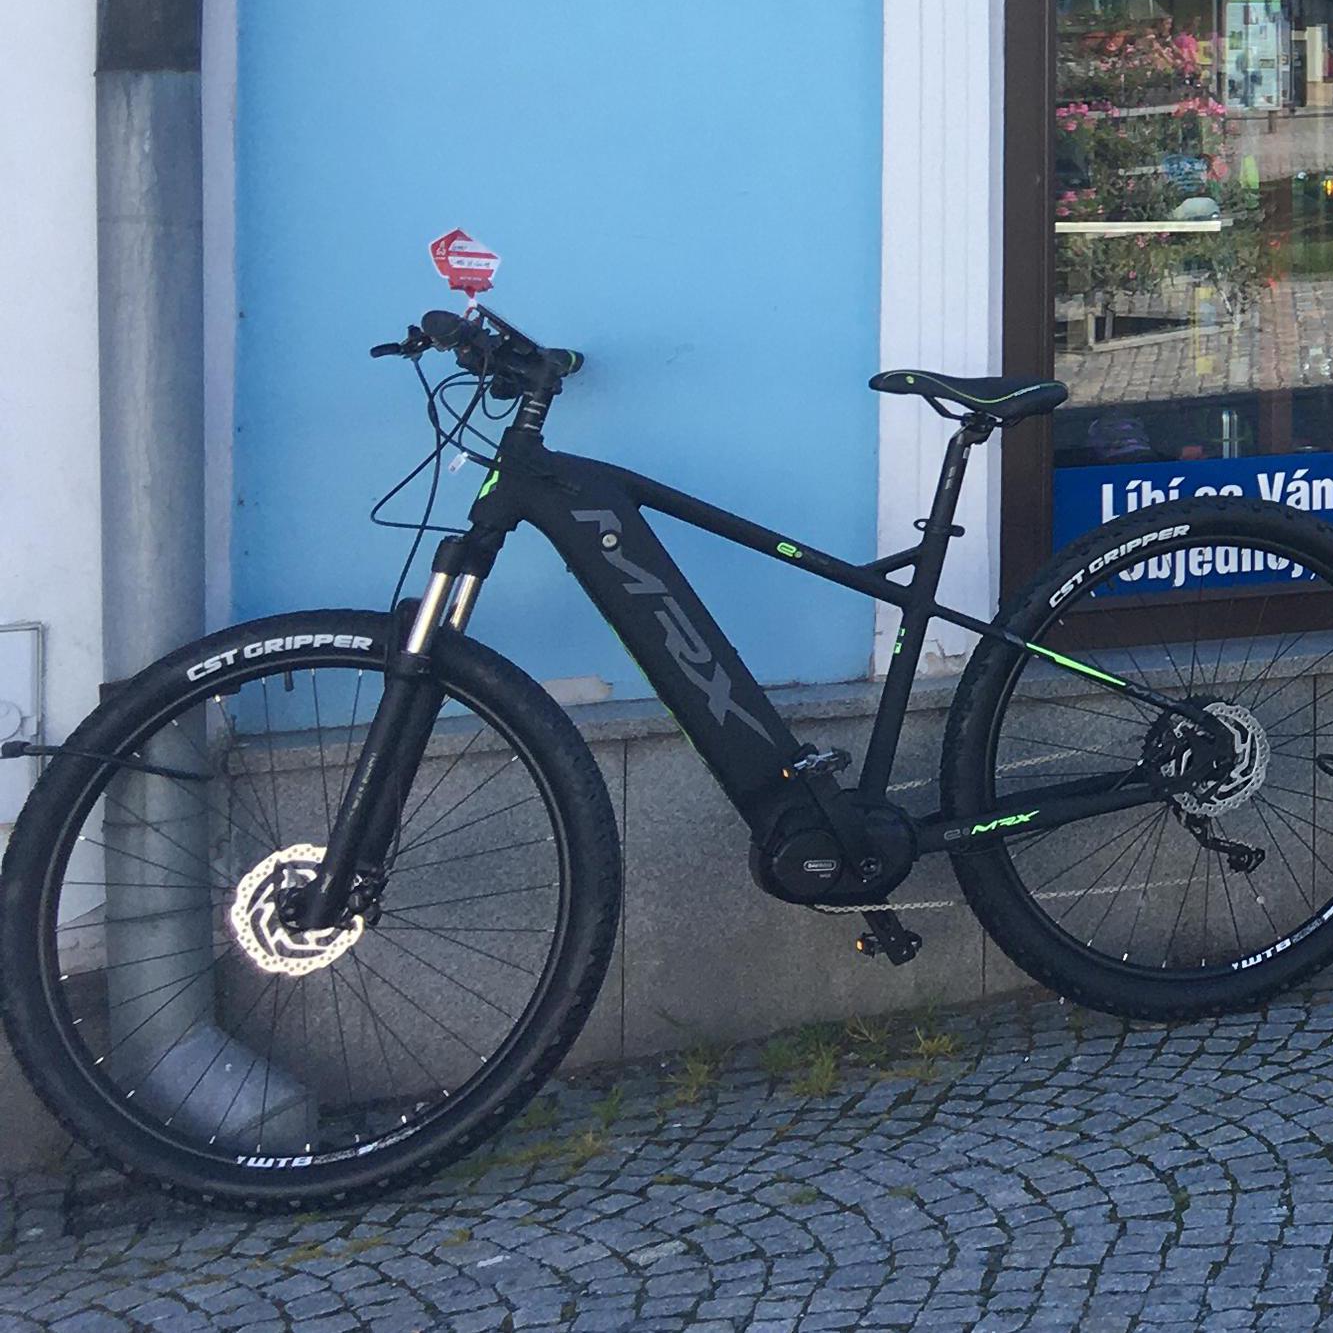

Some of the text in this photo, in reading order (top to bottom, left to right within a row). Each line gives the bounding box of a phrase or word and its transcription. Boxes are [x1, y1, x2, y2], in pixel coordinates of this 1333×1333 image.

[1049, 523, 1191, 609] CST GRIPPER
[185, 633, 374, 682] CST GRIPPER
[1241, 937, 1292, 969] WTB
[246, 1155, 314, 1168] WTB
